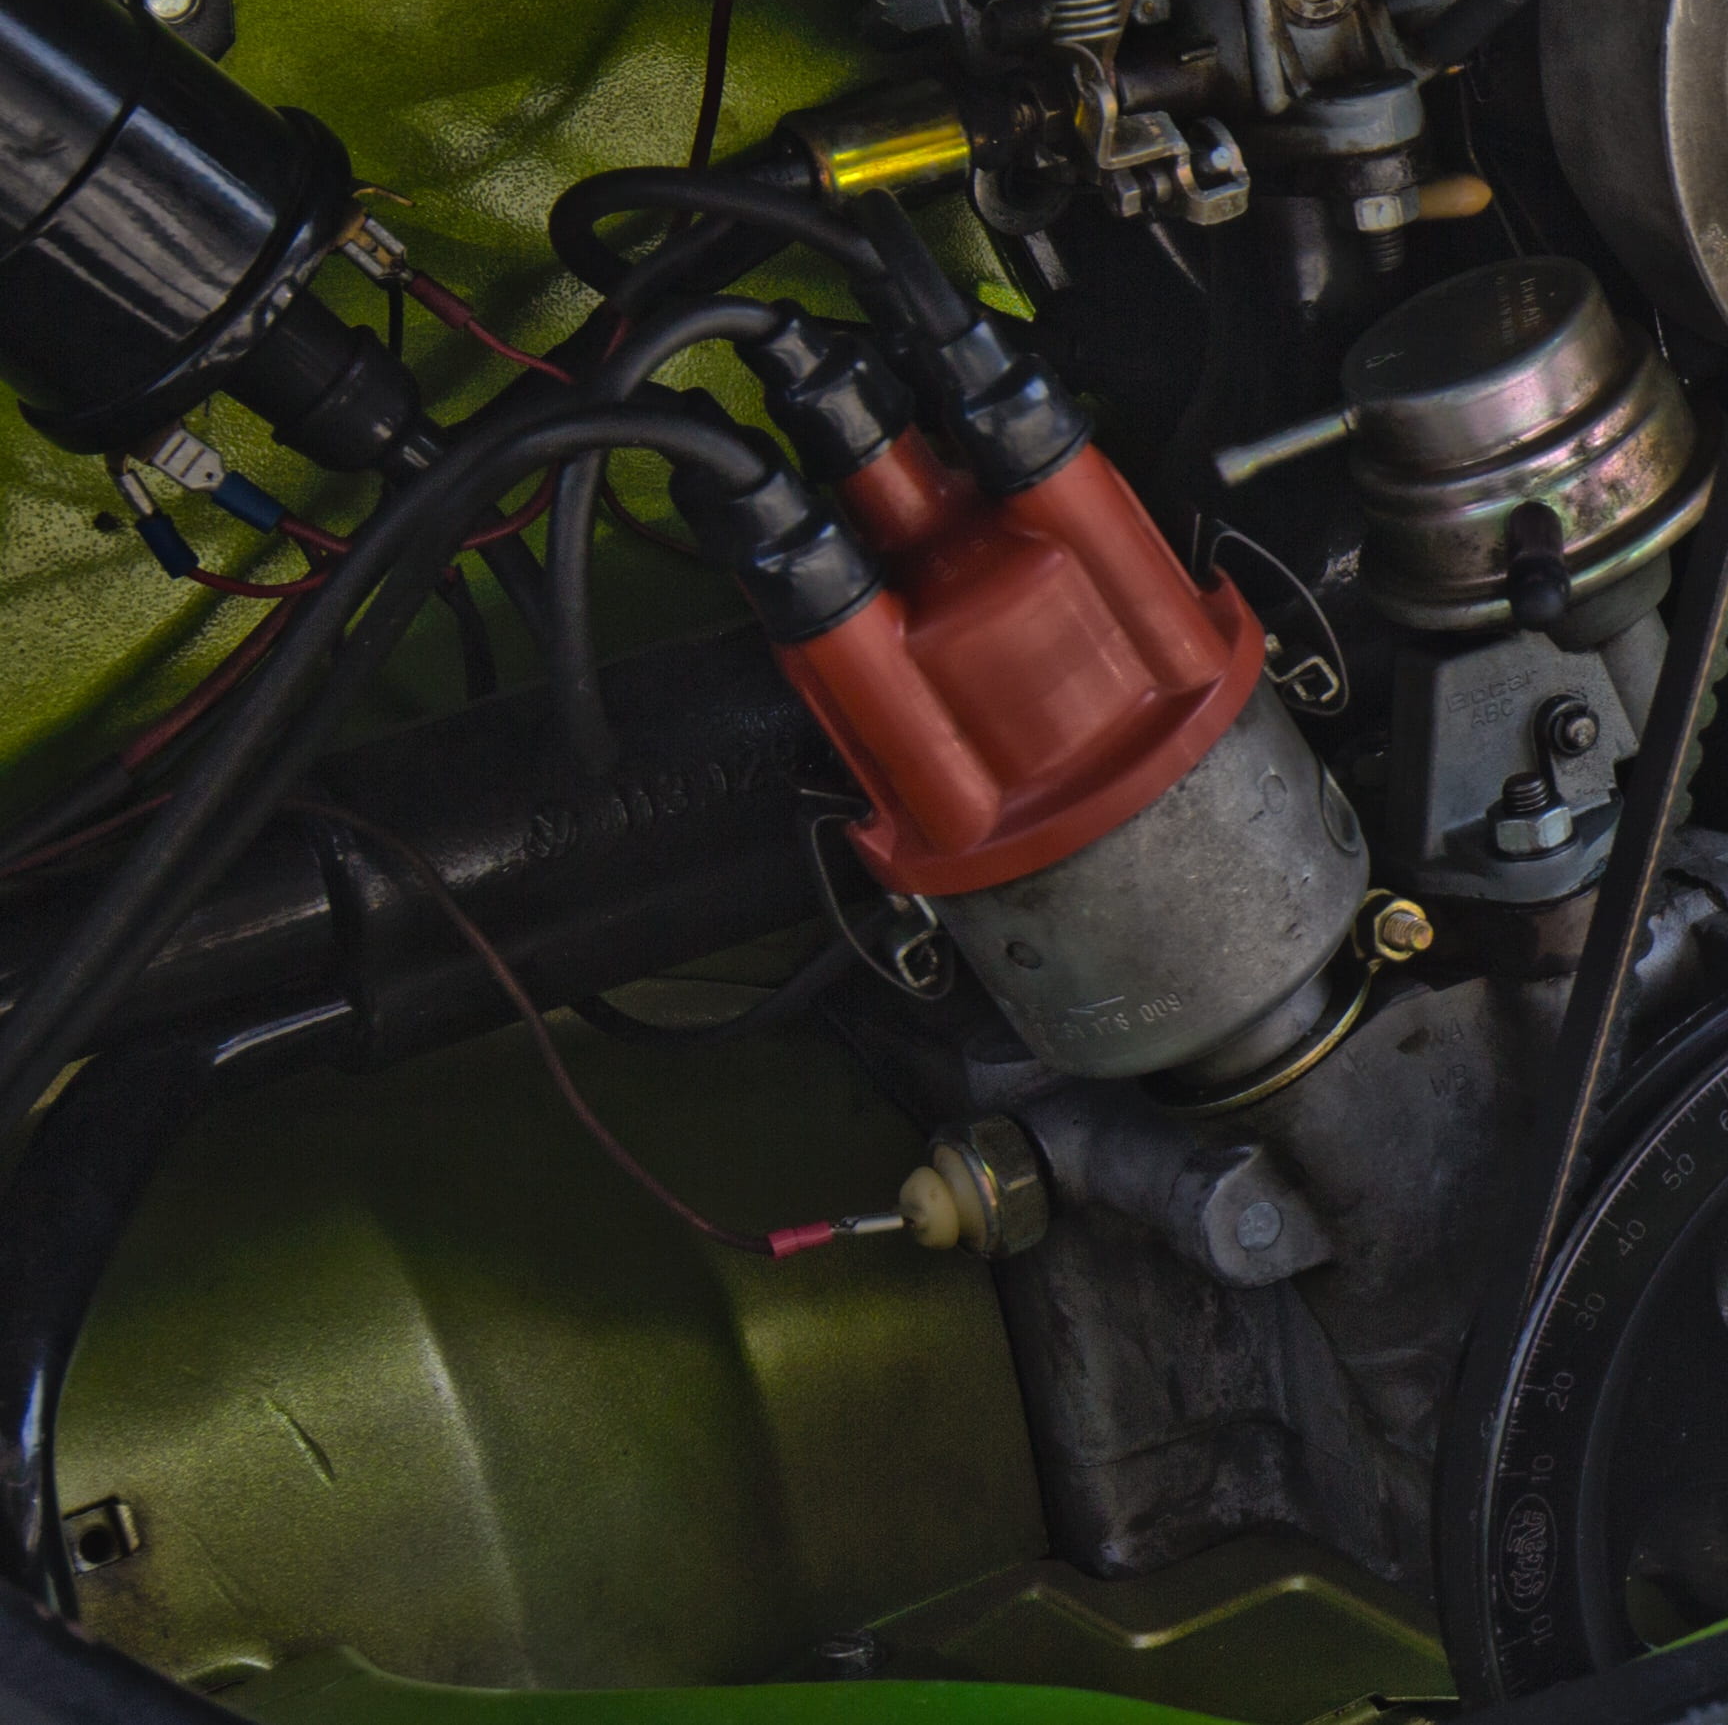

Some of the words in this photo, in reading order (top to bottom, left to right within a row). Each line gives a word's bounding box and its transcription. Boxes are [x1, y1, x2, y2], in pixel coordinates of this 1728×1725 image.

[1138, 991, 1184, 1024] 009
[1545, 1370, 1573, 1413] 20
[1576, 1293, 1609, 1333] 30
[1615, 1219, 1647, 1258] 40
[1661, 1153, 1695, 1191] 50
